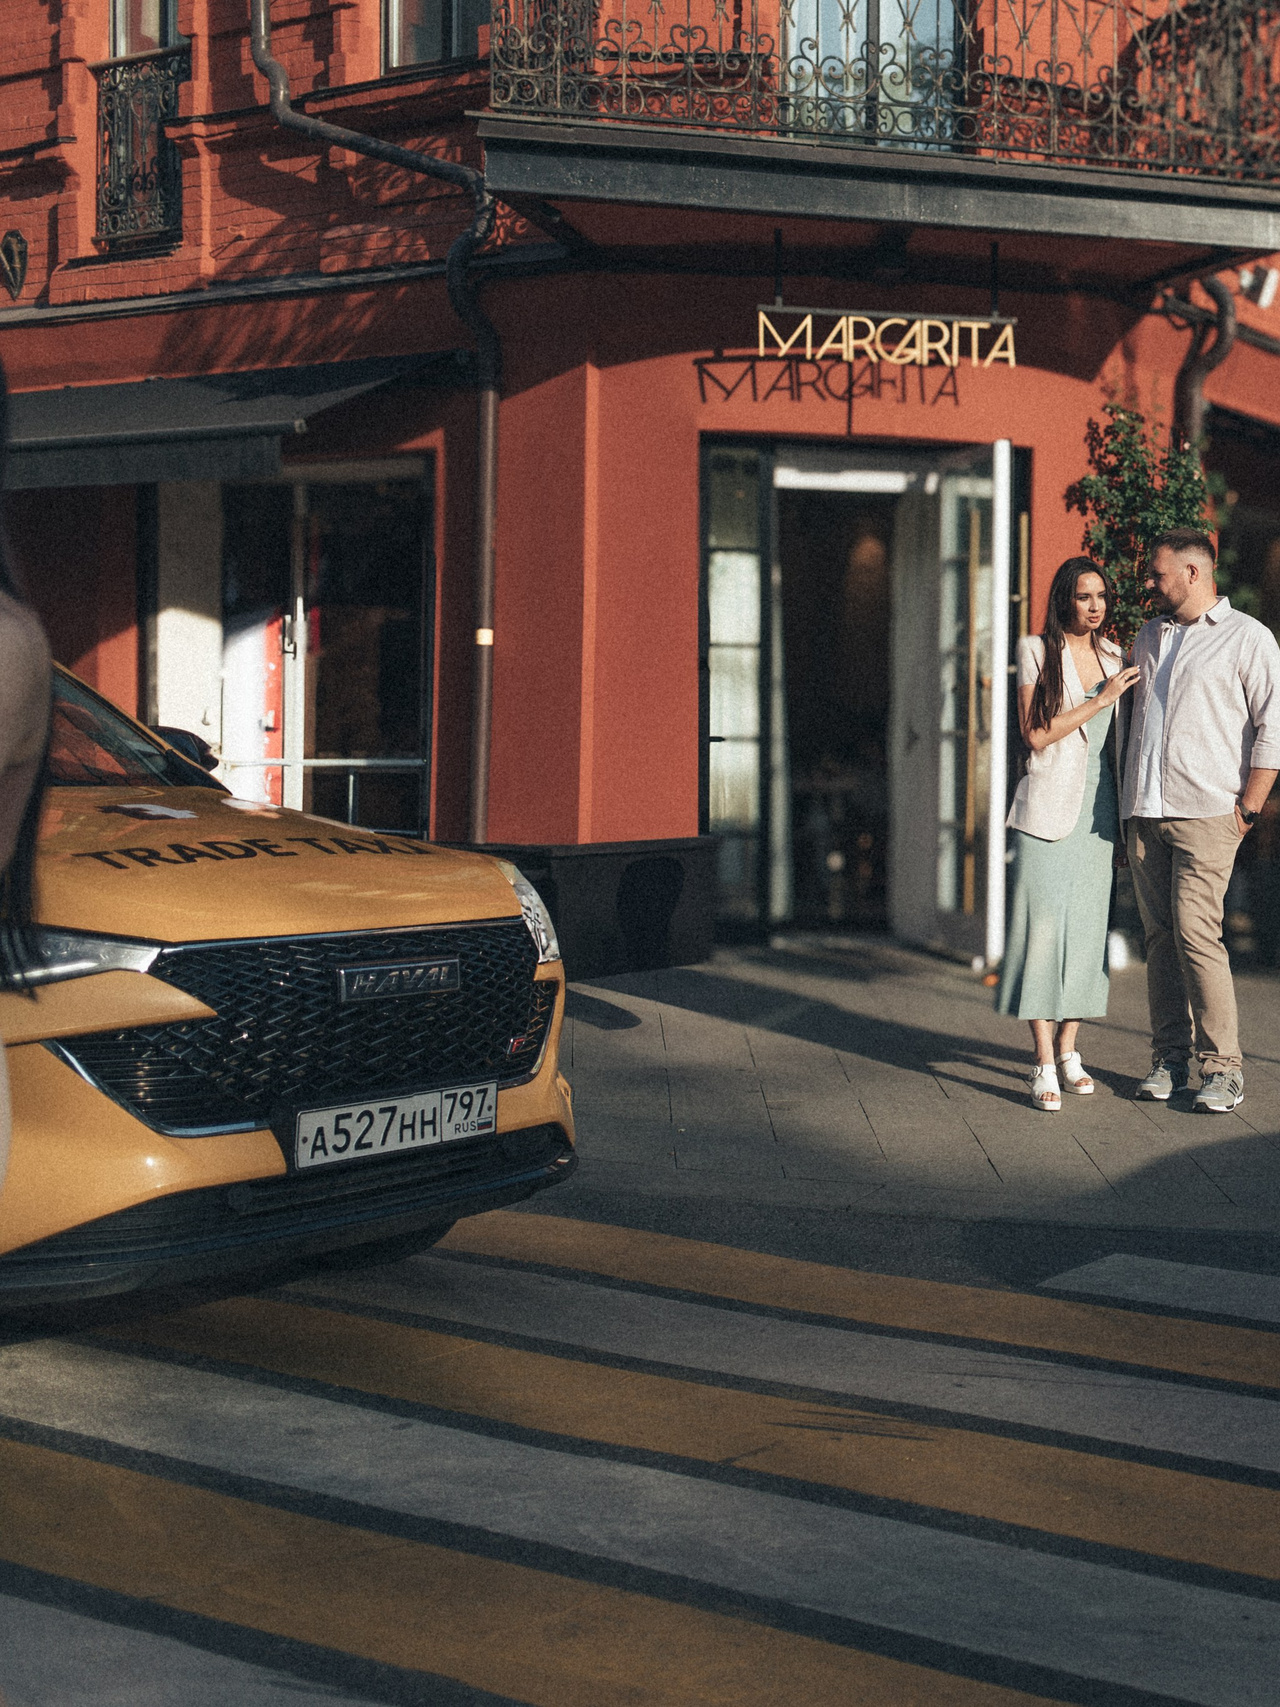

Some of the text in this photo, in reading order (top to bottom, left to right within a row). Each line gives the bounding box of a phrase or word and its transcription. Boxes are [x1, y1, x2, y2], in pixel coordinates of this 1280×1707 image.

[758, 310, 1016, 368] MARGARITA
[72, 836, 432, 870] TRADE TAXI
[352, 966, 451, 994] HAVAL
[444, 1087, 488, 1123] 797
[454, 1119, 477, 1135] RUS
